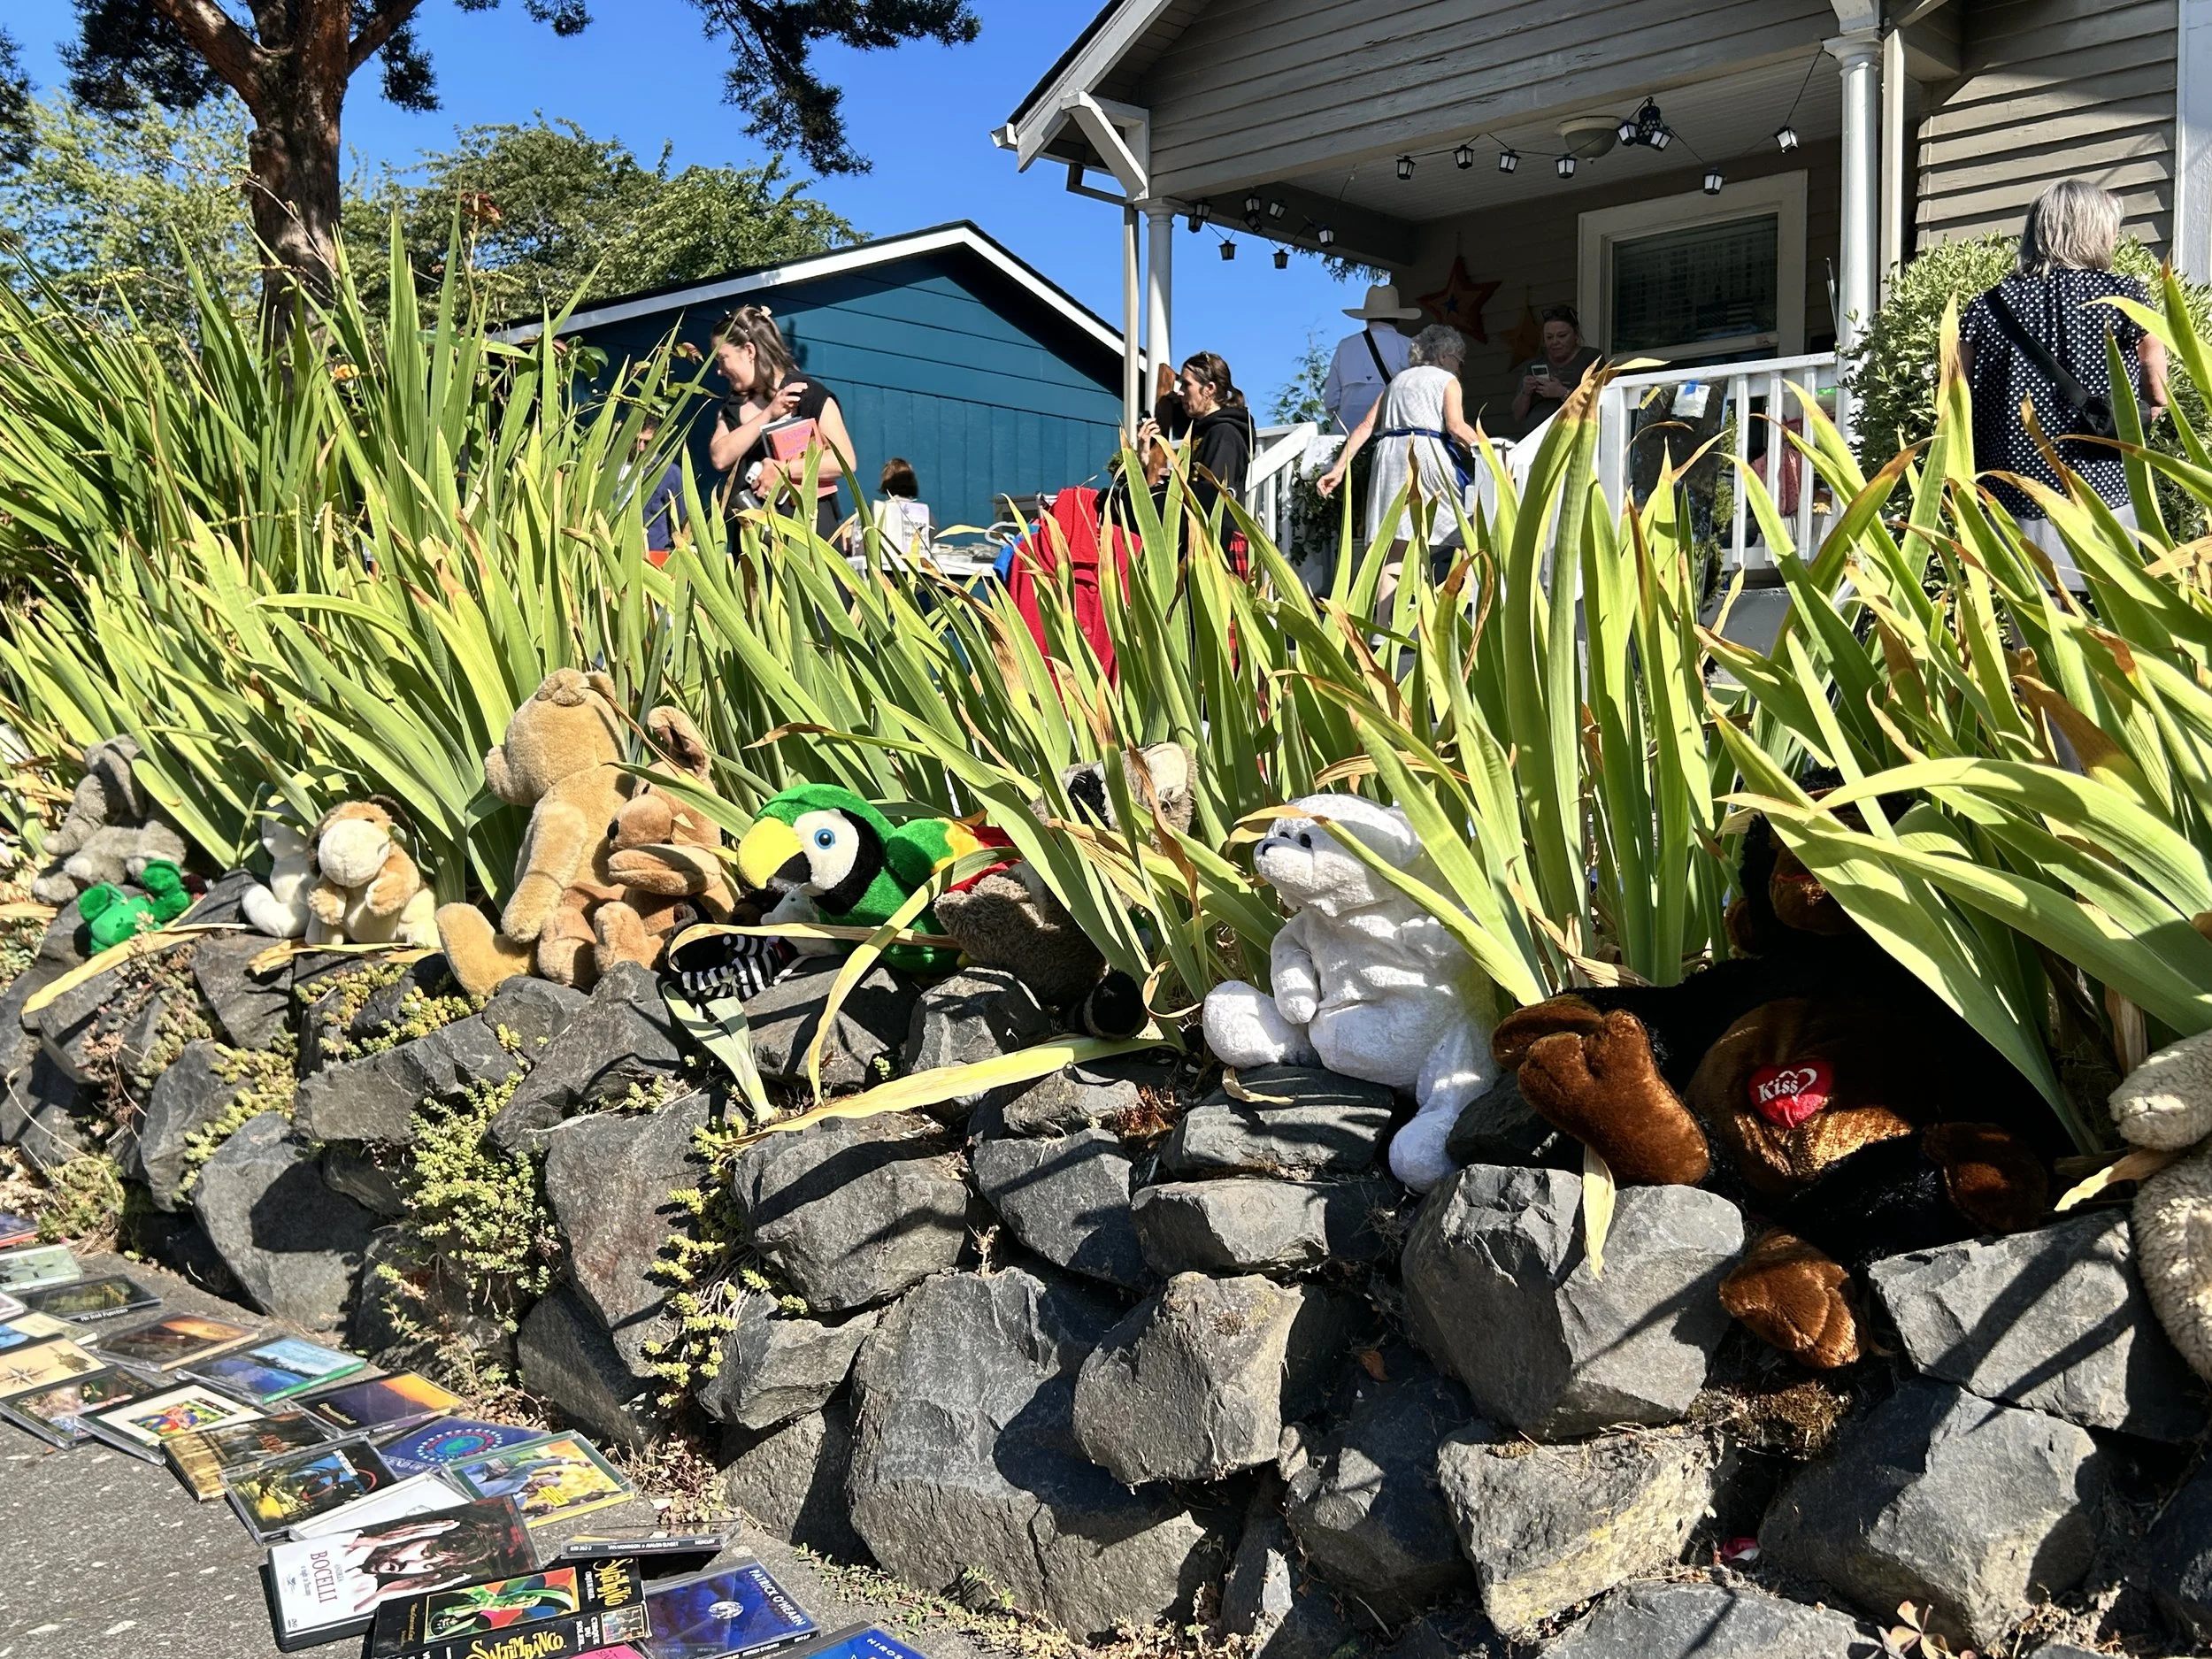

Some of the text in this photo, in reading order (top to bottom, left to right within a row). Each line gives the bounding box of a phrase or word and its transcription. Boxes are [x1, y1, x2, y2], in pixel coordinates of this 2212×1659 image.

[1757, 1078, 1798, 1103] Kiss
[310, 1550, 338, 1603] BOCELLI
[749, 1569, 780, 1598] PATRICK
[772, 1594, 806, 1626] O'HEARN
[584, 1626, 592, 1638] DU
[591, 1617, 600, 1645] CIRQUE
